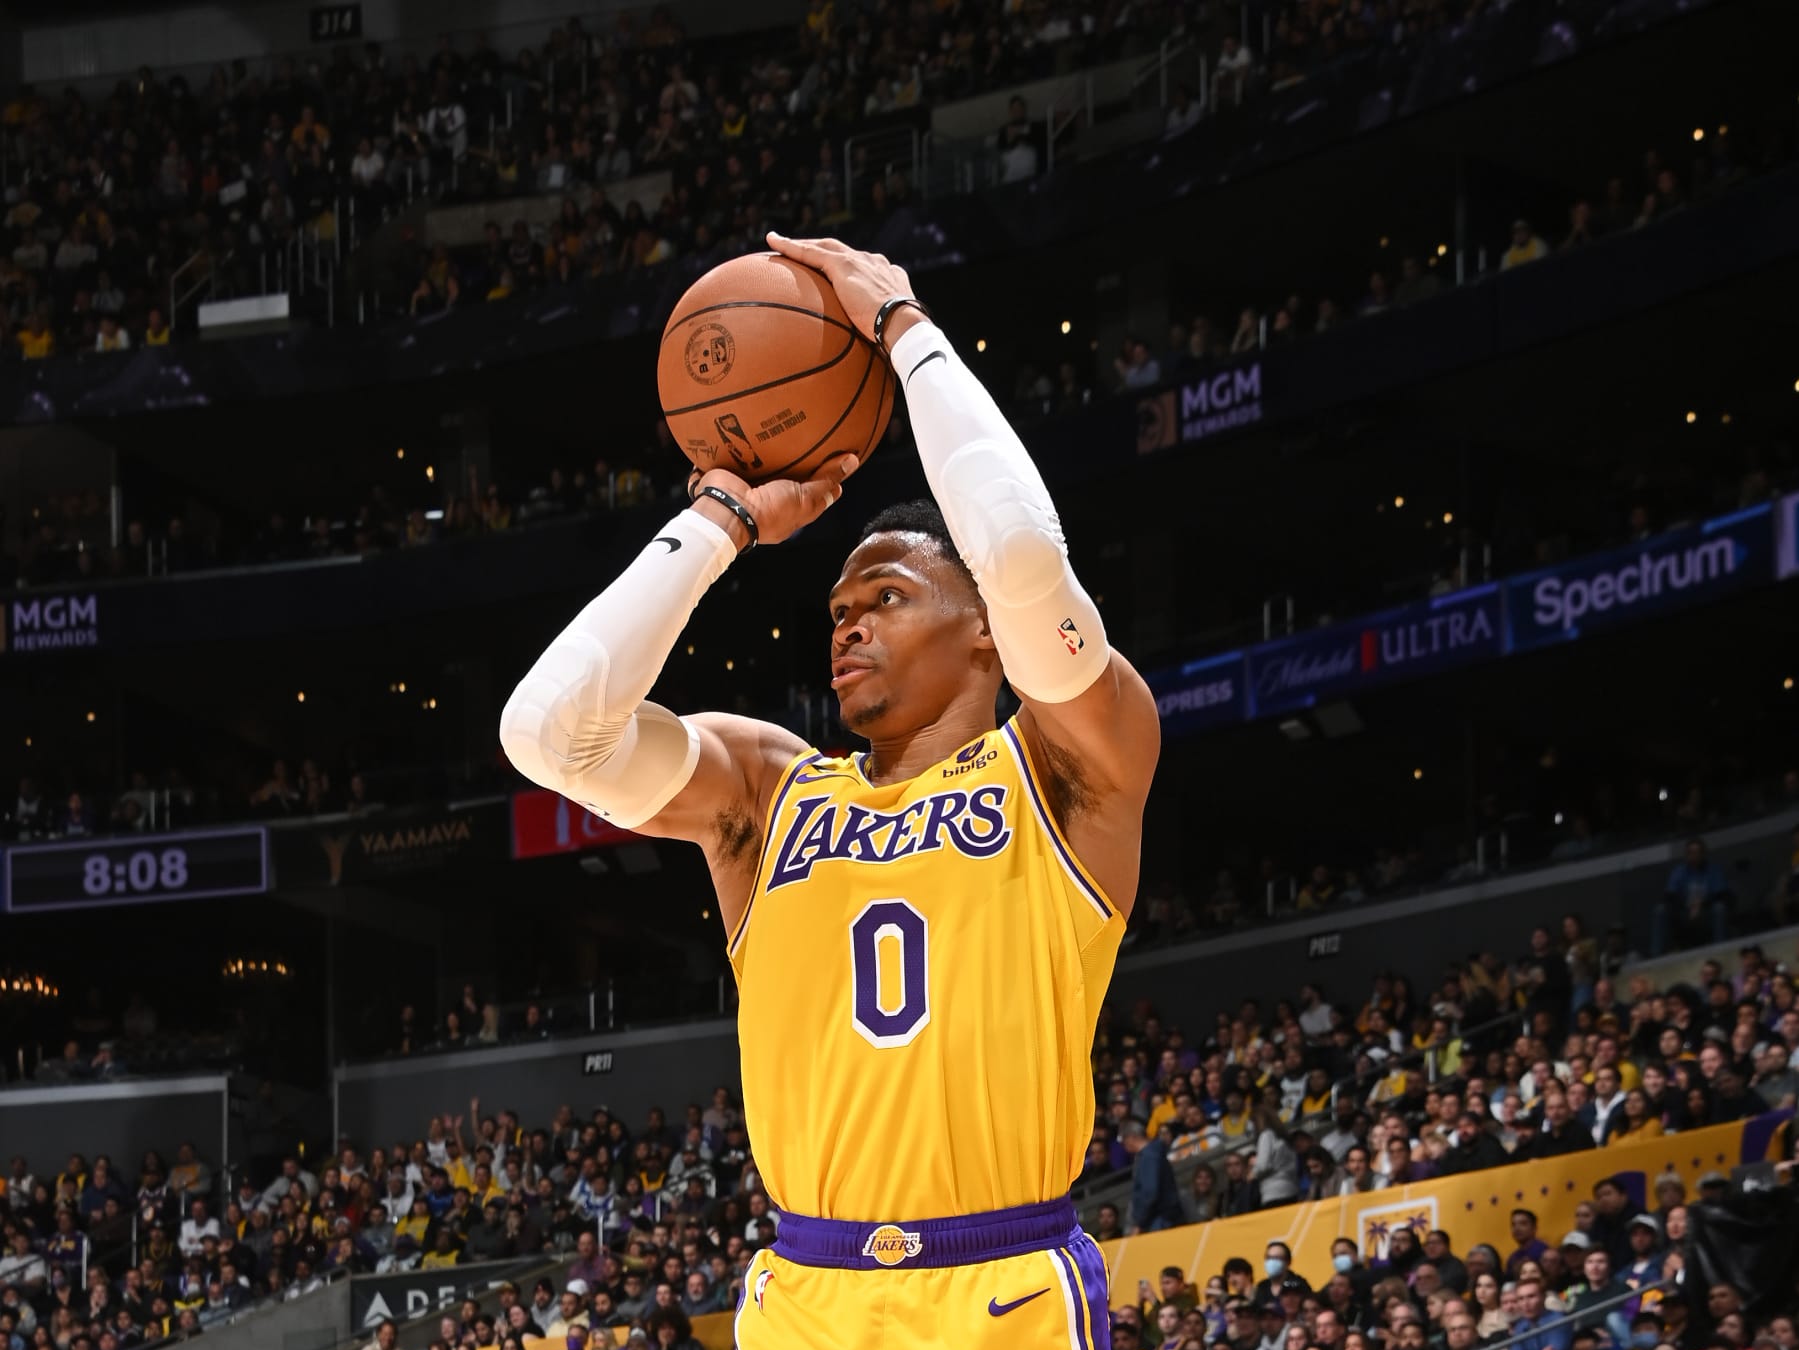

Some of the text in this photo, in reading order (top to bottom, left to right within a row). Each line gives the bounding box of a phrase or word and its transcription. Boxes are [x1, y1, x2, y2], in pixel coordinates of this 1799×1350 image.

[1182, 362, 1261, 419] MGM
[1533, 537, 1735, 631] Spectrum
[12, 594, 97, 632] MGM
[1382, 608, 1493, 664] ULTRA
[942, 749, 998, 779] bibigo
[764, 784, 1015, 897] LAKERS
[83, 849, 189, 895] 8:08
[848, 897, 931, 1050] 0
[865, 1235, 922, 1256] LAKERS
